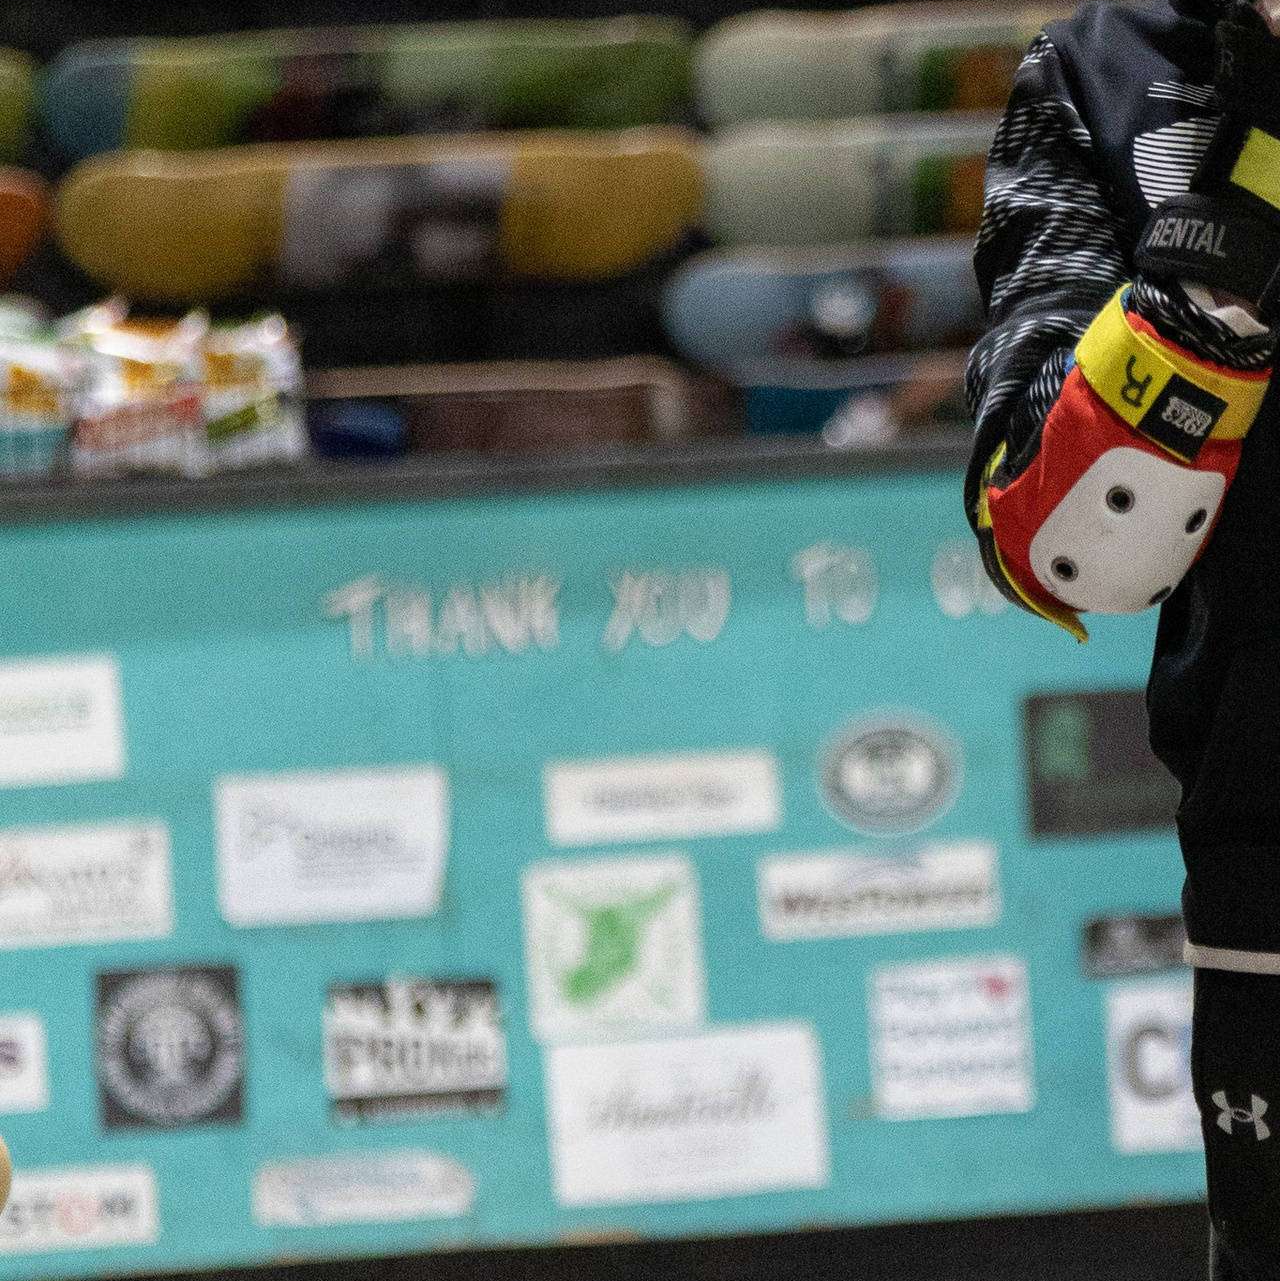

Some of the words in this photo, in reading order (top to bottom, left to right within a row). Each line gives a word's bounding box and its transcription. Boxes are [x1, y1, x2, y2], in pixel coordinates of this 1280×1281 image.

[1146, 217, 1228, 259] RENTAL
[322, 570, 563, 660] THANK
[604, 566, 733, 652] YOU
[790, 540, 879, 628] TO
